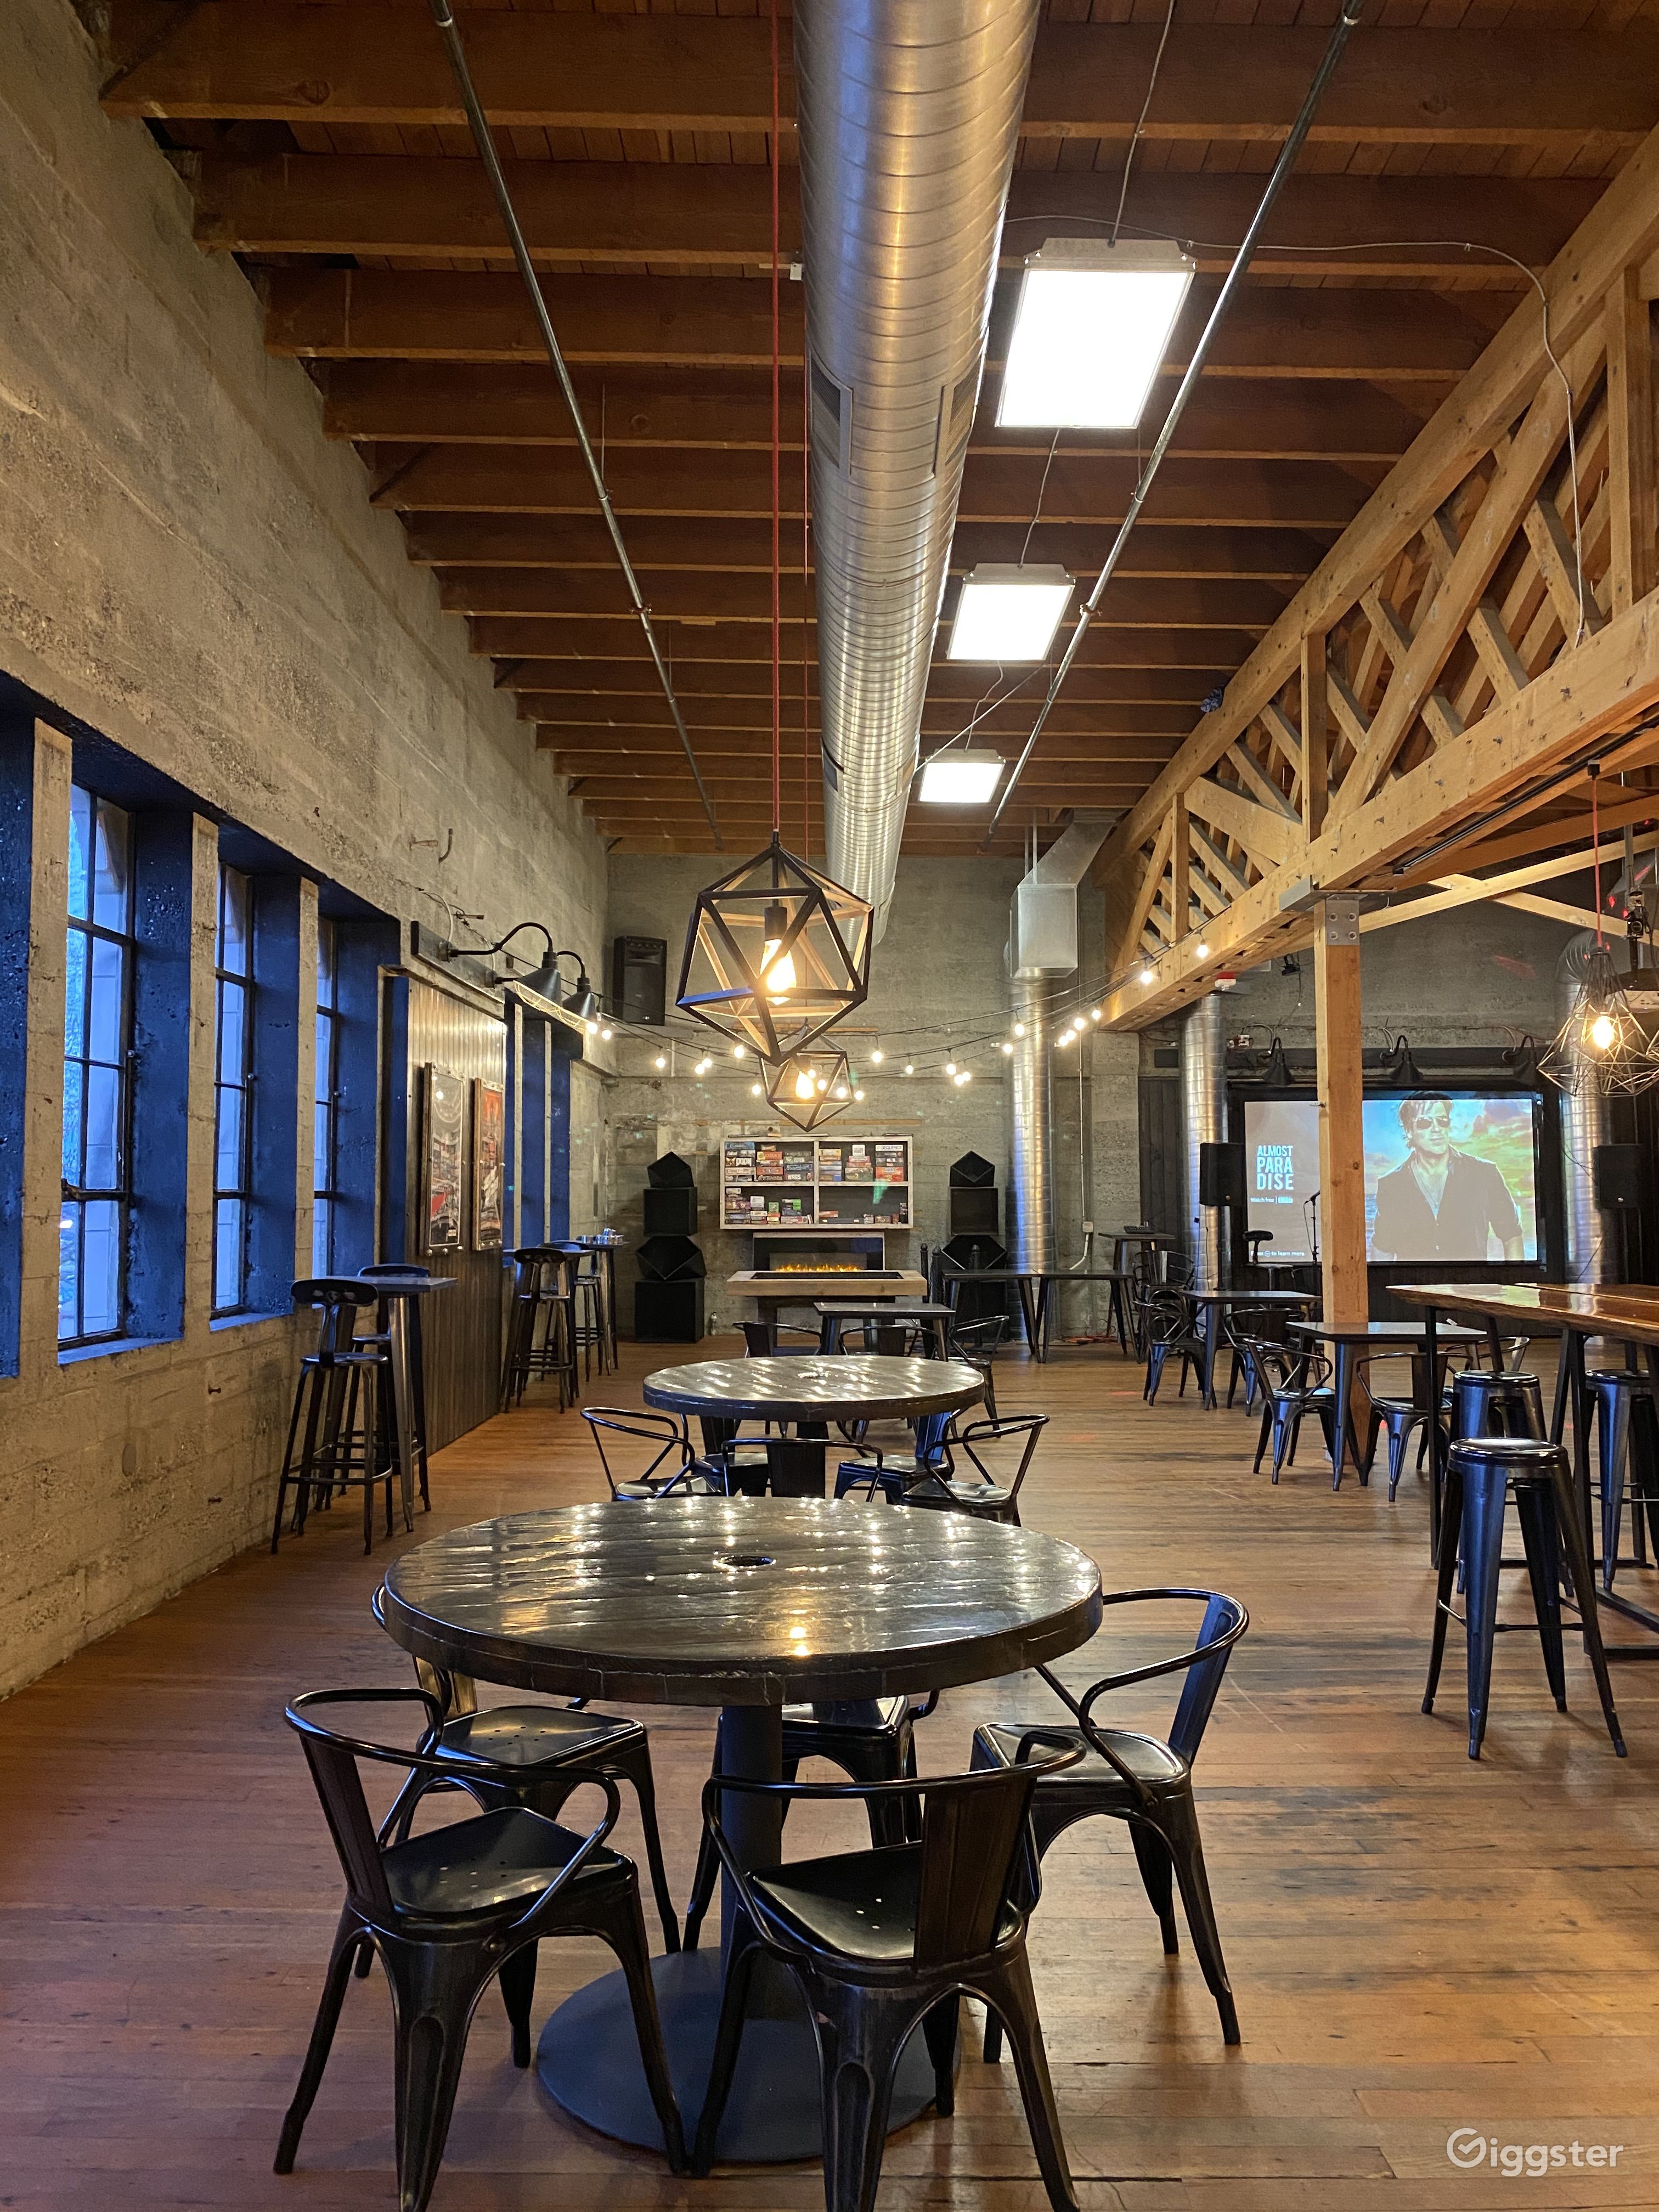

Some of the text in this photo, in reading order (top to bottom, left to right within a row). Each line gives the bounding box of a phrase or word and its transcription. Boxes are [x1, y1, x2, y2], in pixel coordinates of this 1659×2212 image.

[1257, 1145, 1293, 1156] ALMOST
[1257, 1156, 1293, 1173] PARA
[1257, 1173, 1294, 1190] DISE
